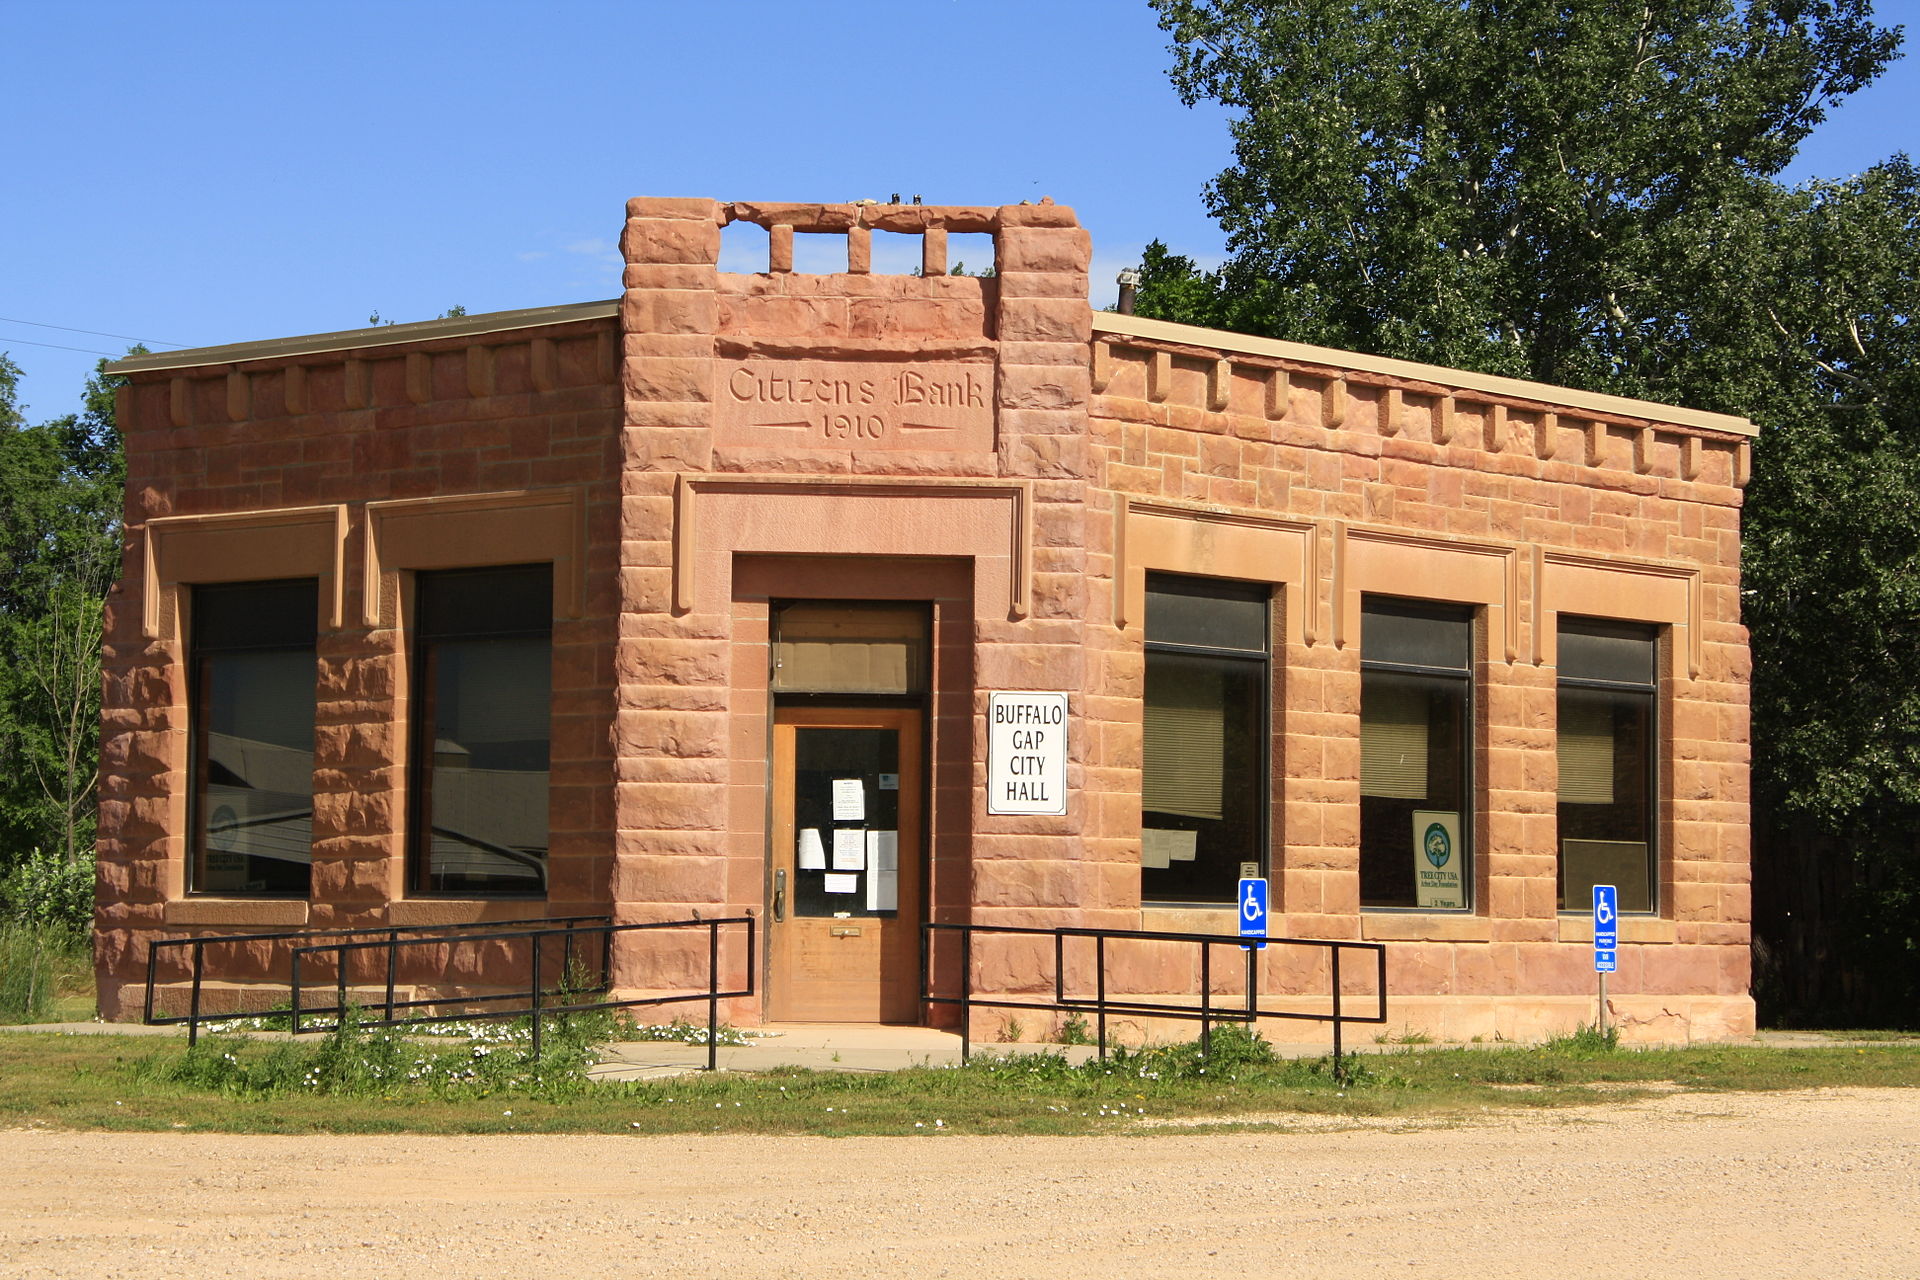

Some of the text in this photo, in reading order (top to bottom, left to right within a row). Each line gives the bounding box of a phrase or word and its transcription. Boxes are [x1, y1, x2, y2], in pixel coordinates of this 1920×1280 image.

[729, 367, 985, 408] Citizens Bank
[823, 414, 885, 440] 1910
[995, 704, 1062, 725] BUFFALO
[1012, 730, 1045, 750] GAP
[1010, 755, 1046, 776] CITY
[1006, 781, 1049, 801] HALL
[1419, 871, 1458, 880] TREE CITY USA
